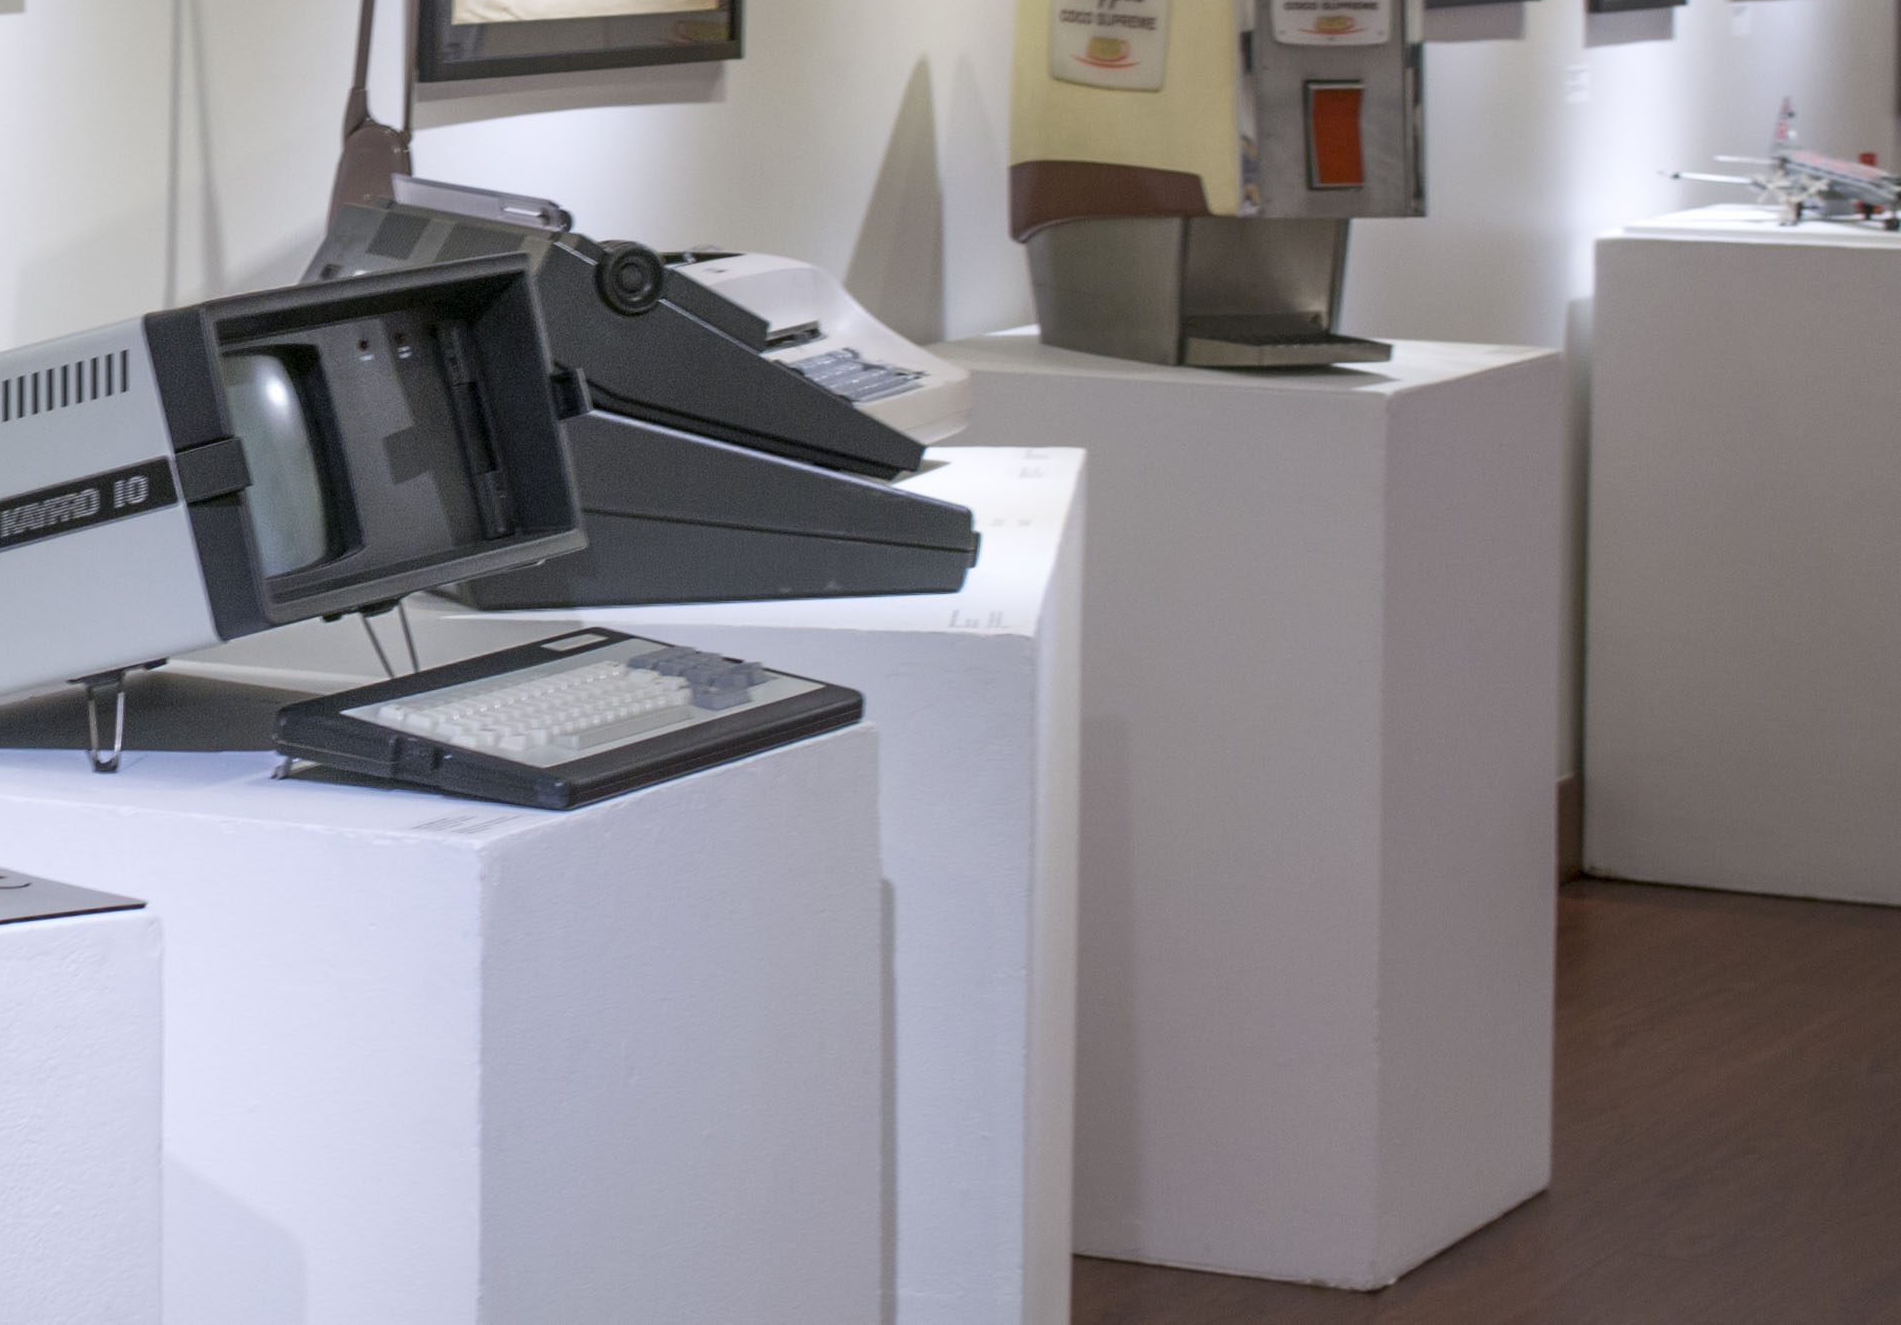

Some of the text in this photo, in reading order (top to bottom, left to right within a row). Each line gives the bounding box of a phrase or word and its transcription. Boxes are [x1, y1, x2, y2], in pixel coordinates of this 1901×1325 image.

[1322, 1, 1380, 11] SUPREME
[1096, 12, 1158, 31] SUPREME
[0, 474, 149, 538] KAYPRO 10
